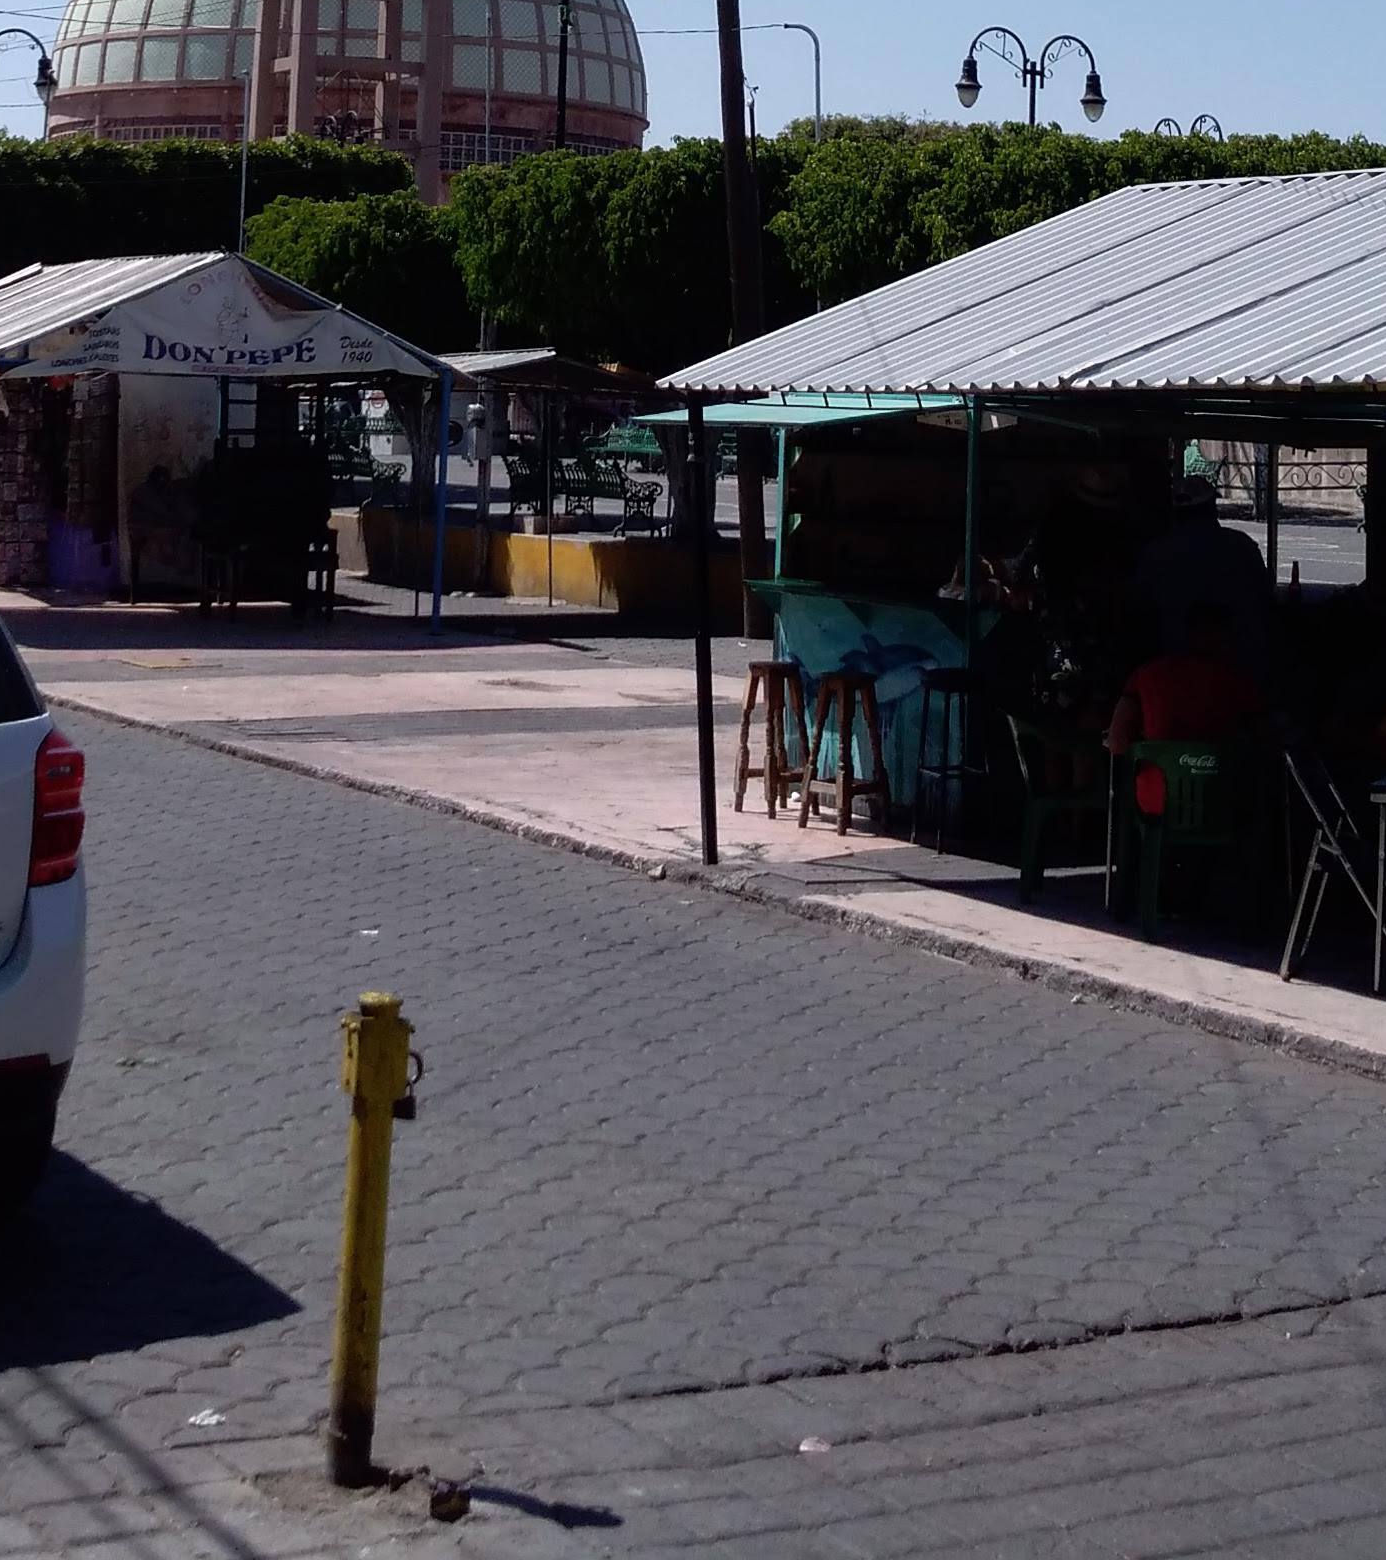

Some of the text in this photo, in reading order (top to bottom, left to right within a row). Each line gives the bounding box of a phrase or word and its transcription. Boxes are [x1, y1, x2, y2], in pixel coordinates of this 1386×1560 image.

[142, 332, 317, 366] DON PEPE
[339, 336, 375, 351] Desde
[341, 350, 374, 365] 1940
